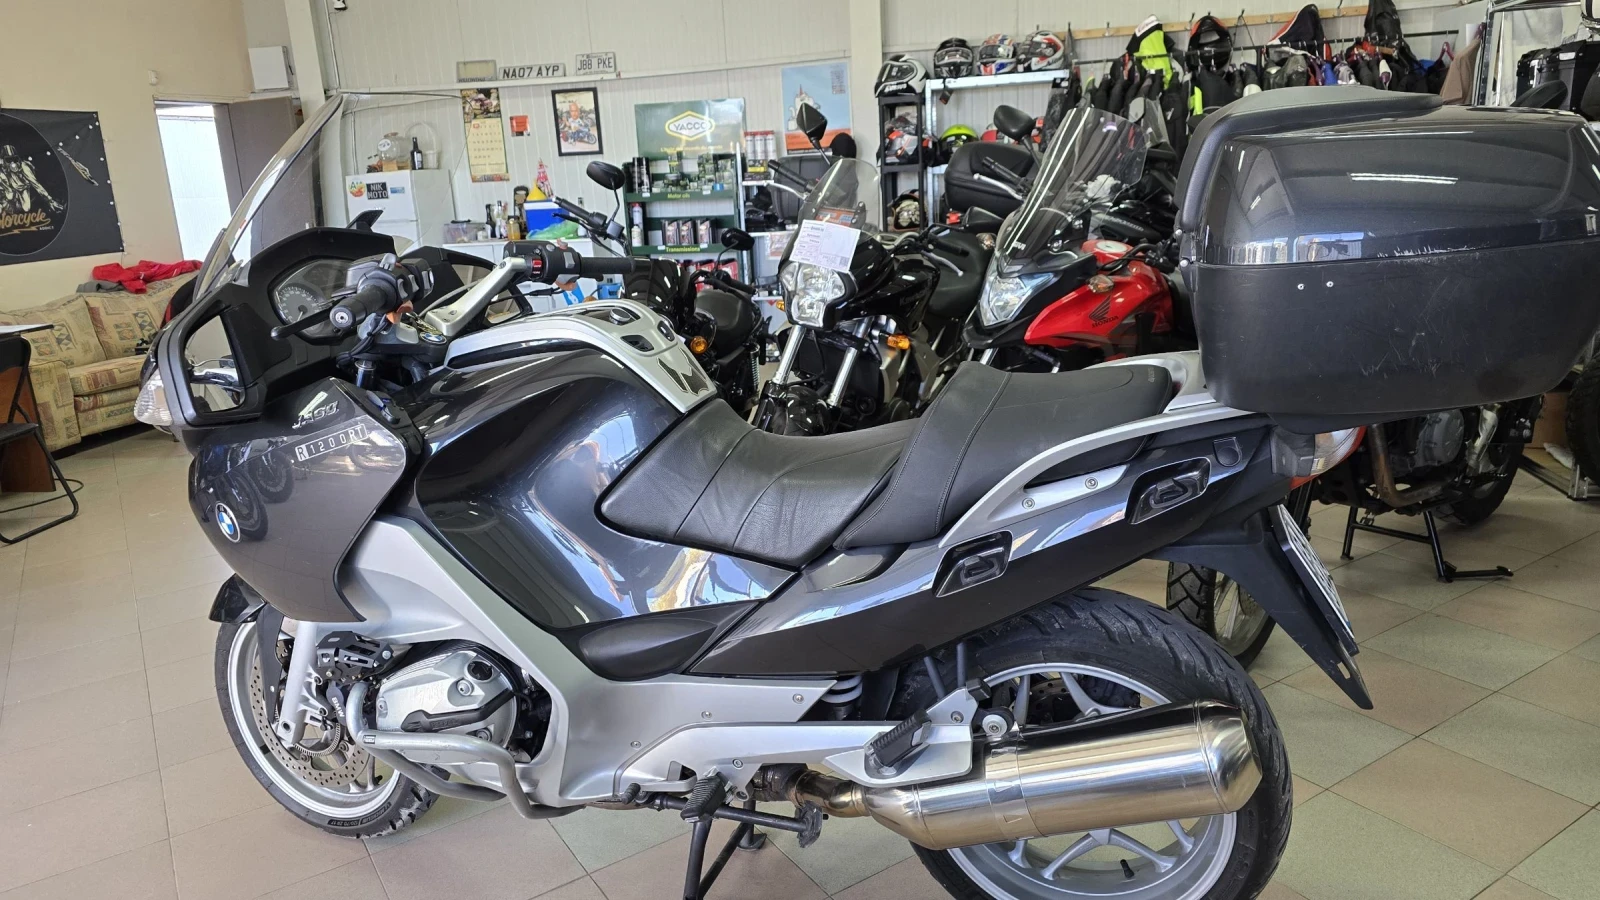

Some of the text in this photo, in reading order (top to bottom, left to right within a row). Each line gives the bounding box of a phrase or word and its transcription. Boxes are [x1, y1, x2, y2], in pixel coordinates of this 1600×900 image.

[597, 56, 613, 69] PKE
[536, 65, 560, 77] AYP
[370, 183, 384, 191] NIK
[0, 207, 50, 229] torcycle
[1091, 315, 1120, 328] HONDA
[331, 696, 345, 717] BMW
